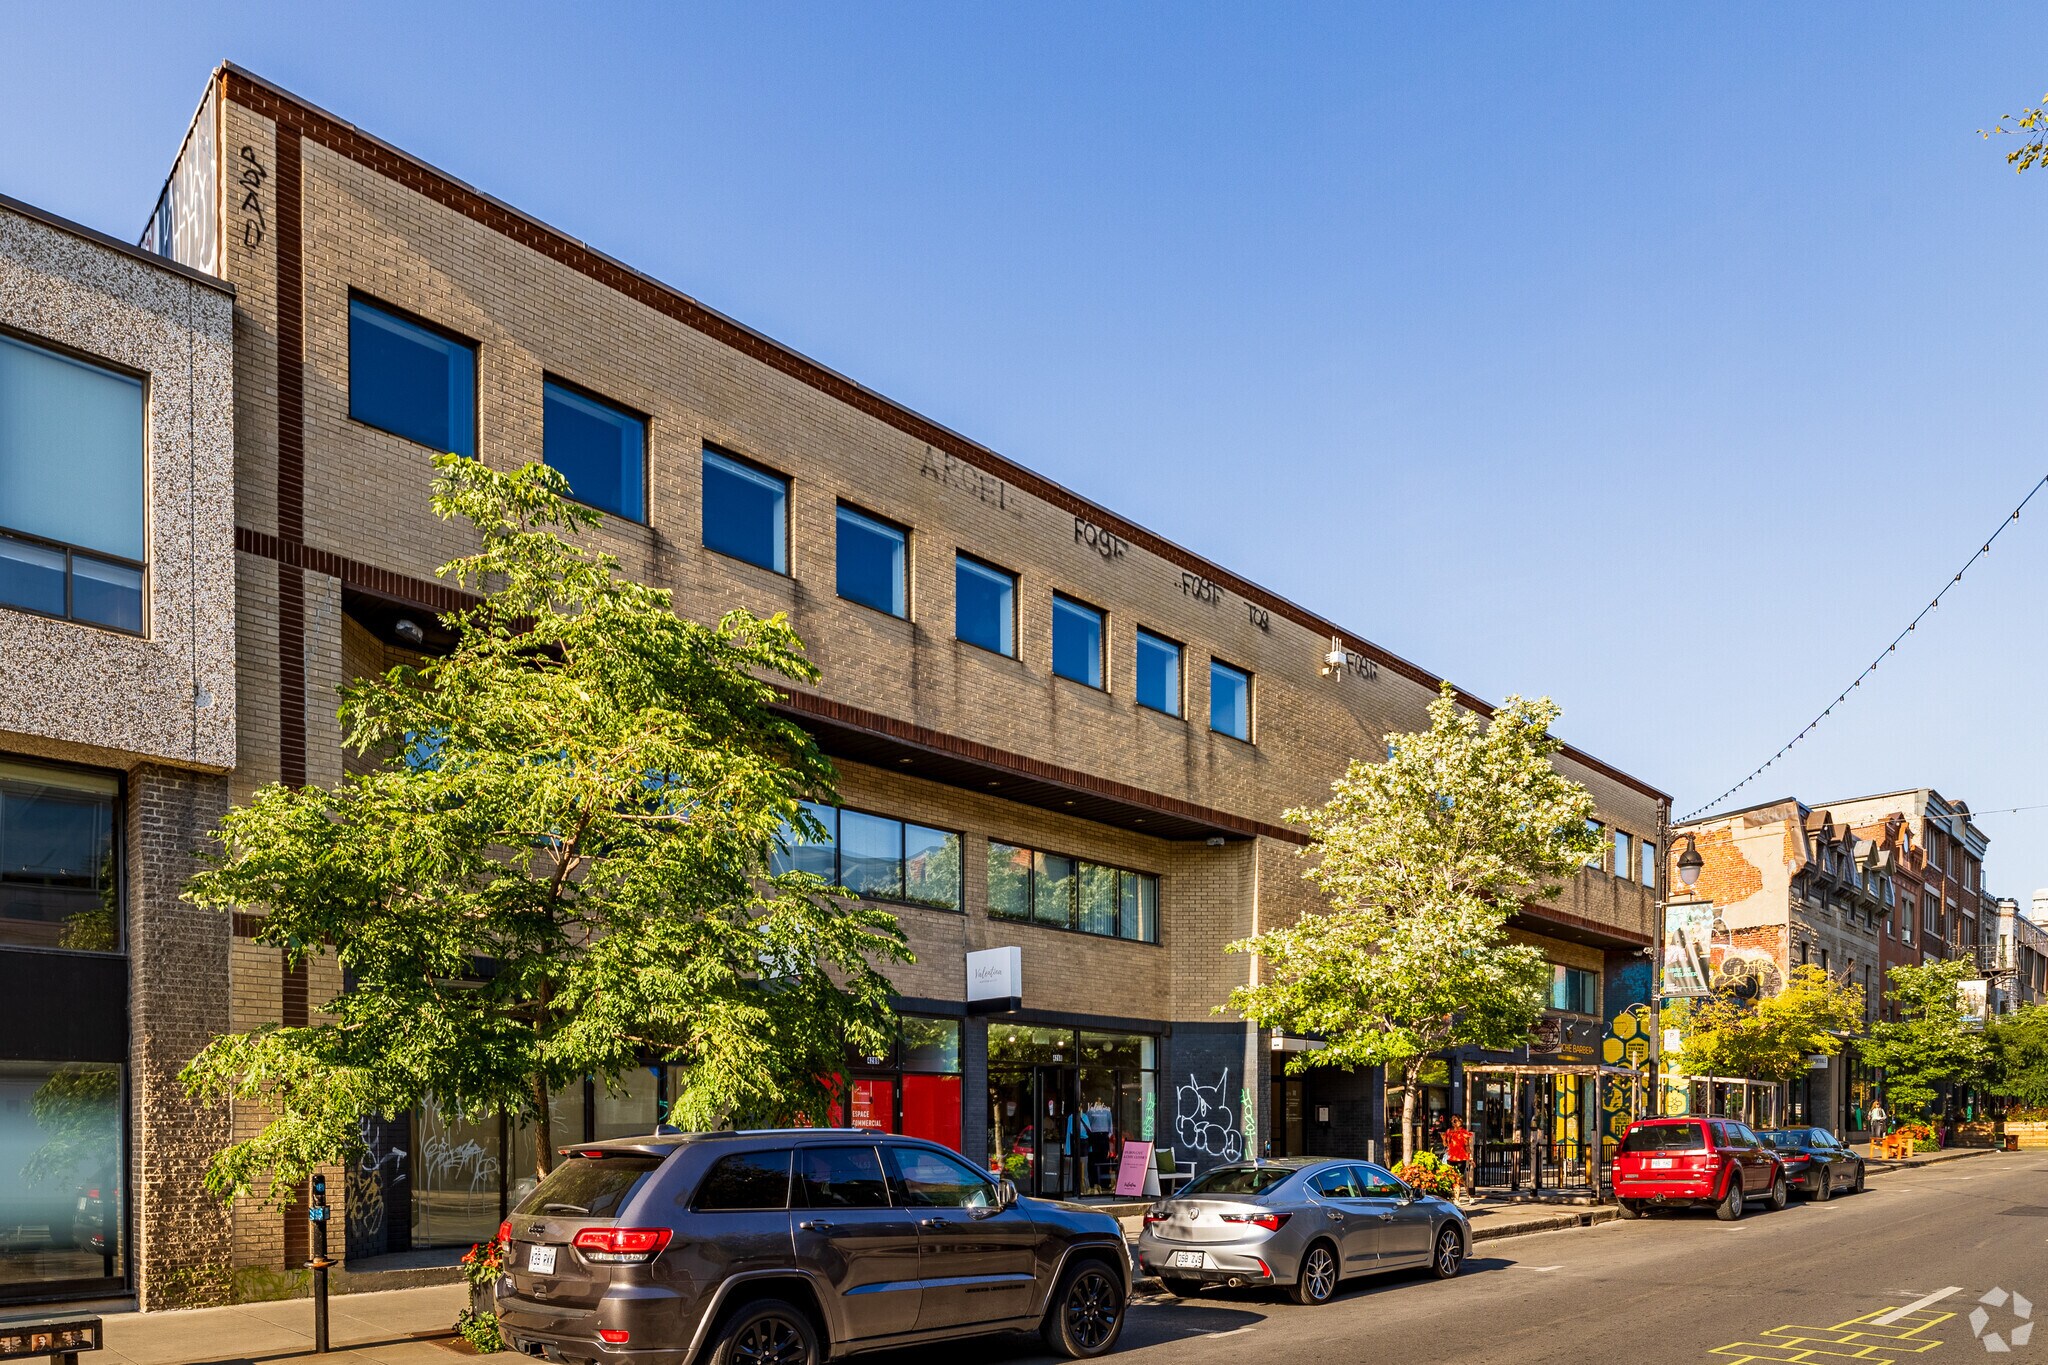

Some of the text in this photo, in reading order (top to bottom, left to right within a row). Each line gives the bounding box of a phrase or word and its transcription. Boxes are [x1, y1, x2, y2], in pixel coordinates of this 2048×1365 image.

[974, 965, 1002, 979] Valentina
[852, 1110, 870, 1118] ESPACE
[852, 1119, 882, 1127] COMMERCIAL
